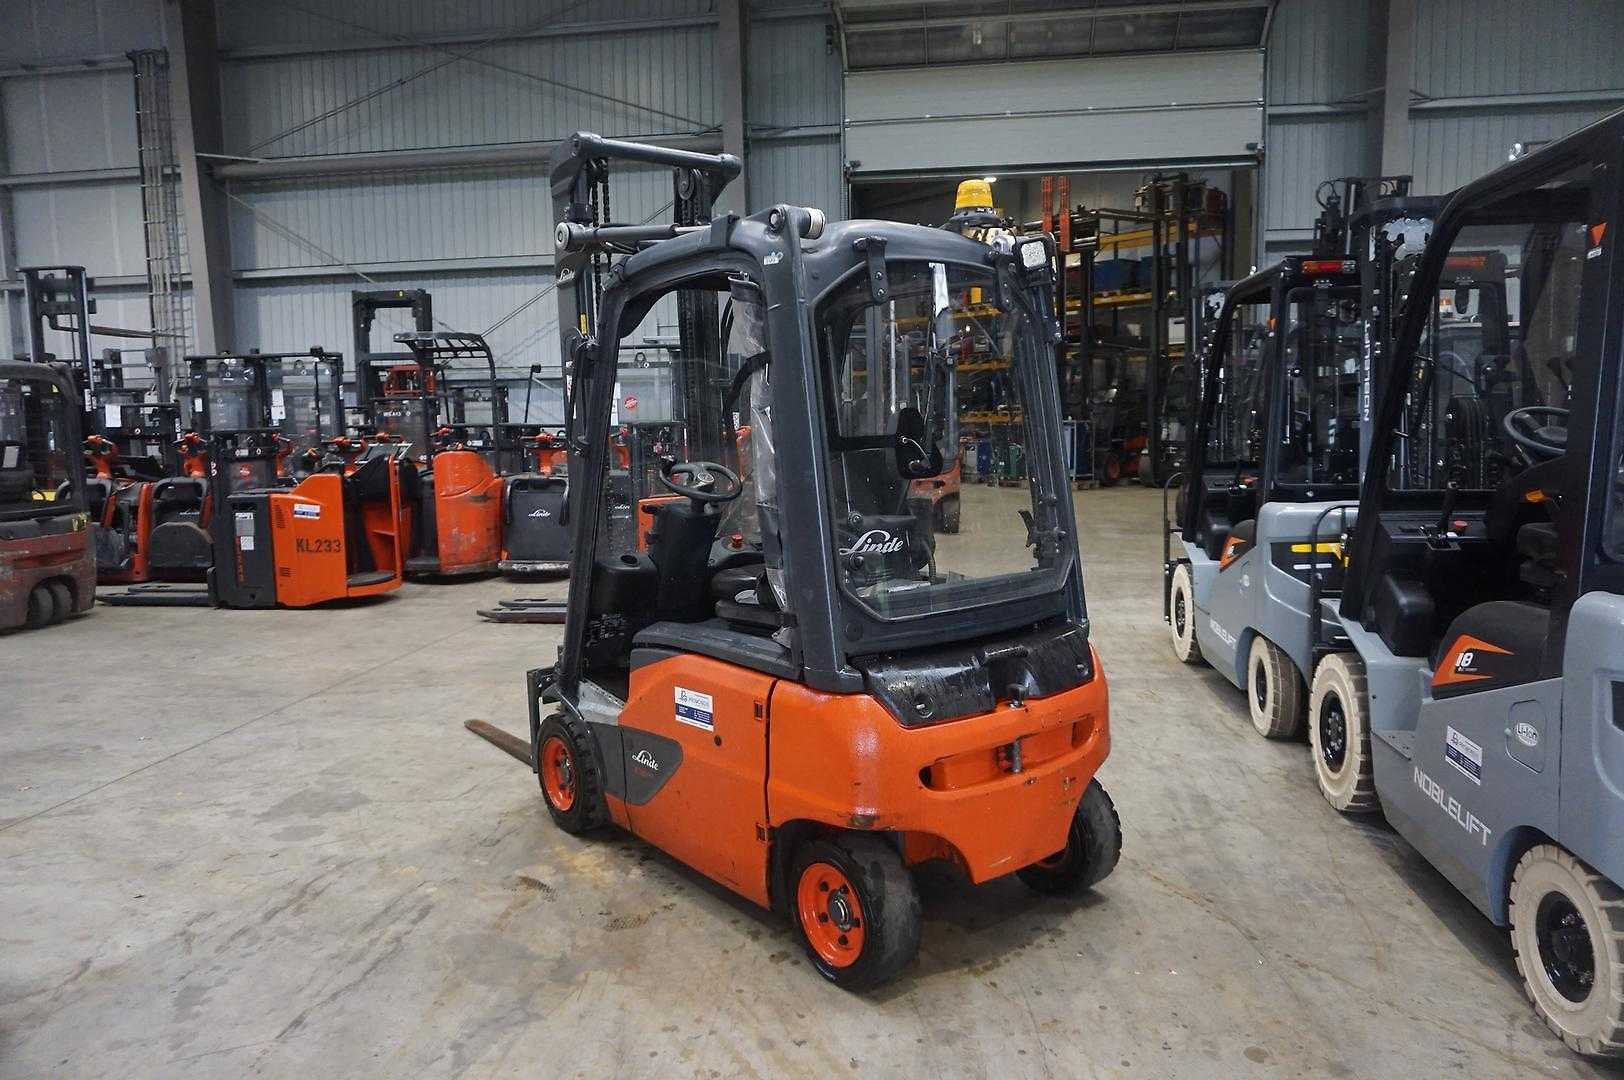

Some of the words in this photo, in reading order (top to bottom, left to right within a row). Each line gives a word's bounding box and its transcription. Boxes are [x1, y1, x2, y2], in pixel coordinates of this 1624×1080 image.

[295, 538, 341, 553] KL233
[839, 529, 904, 556] Linde
[1455, 652, 1474, 667] 18
[632, 750, 658, 771] Linde
[1414, 766, 1491, 847] NOBLELIFT
